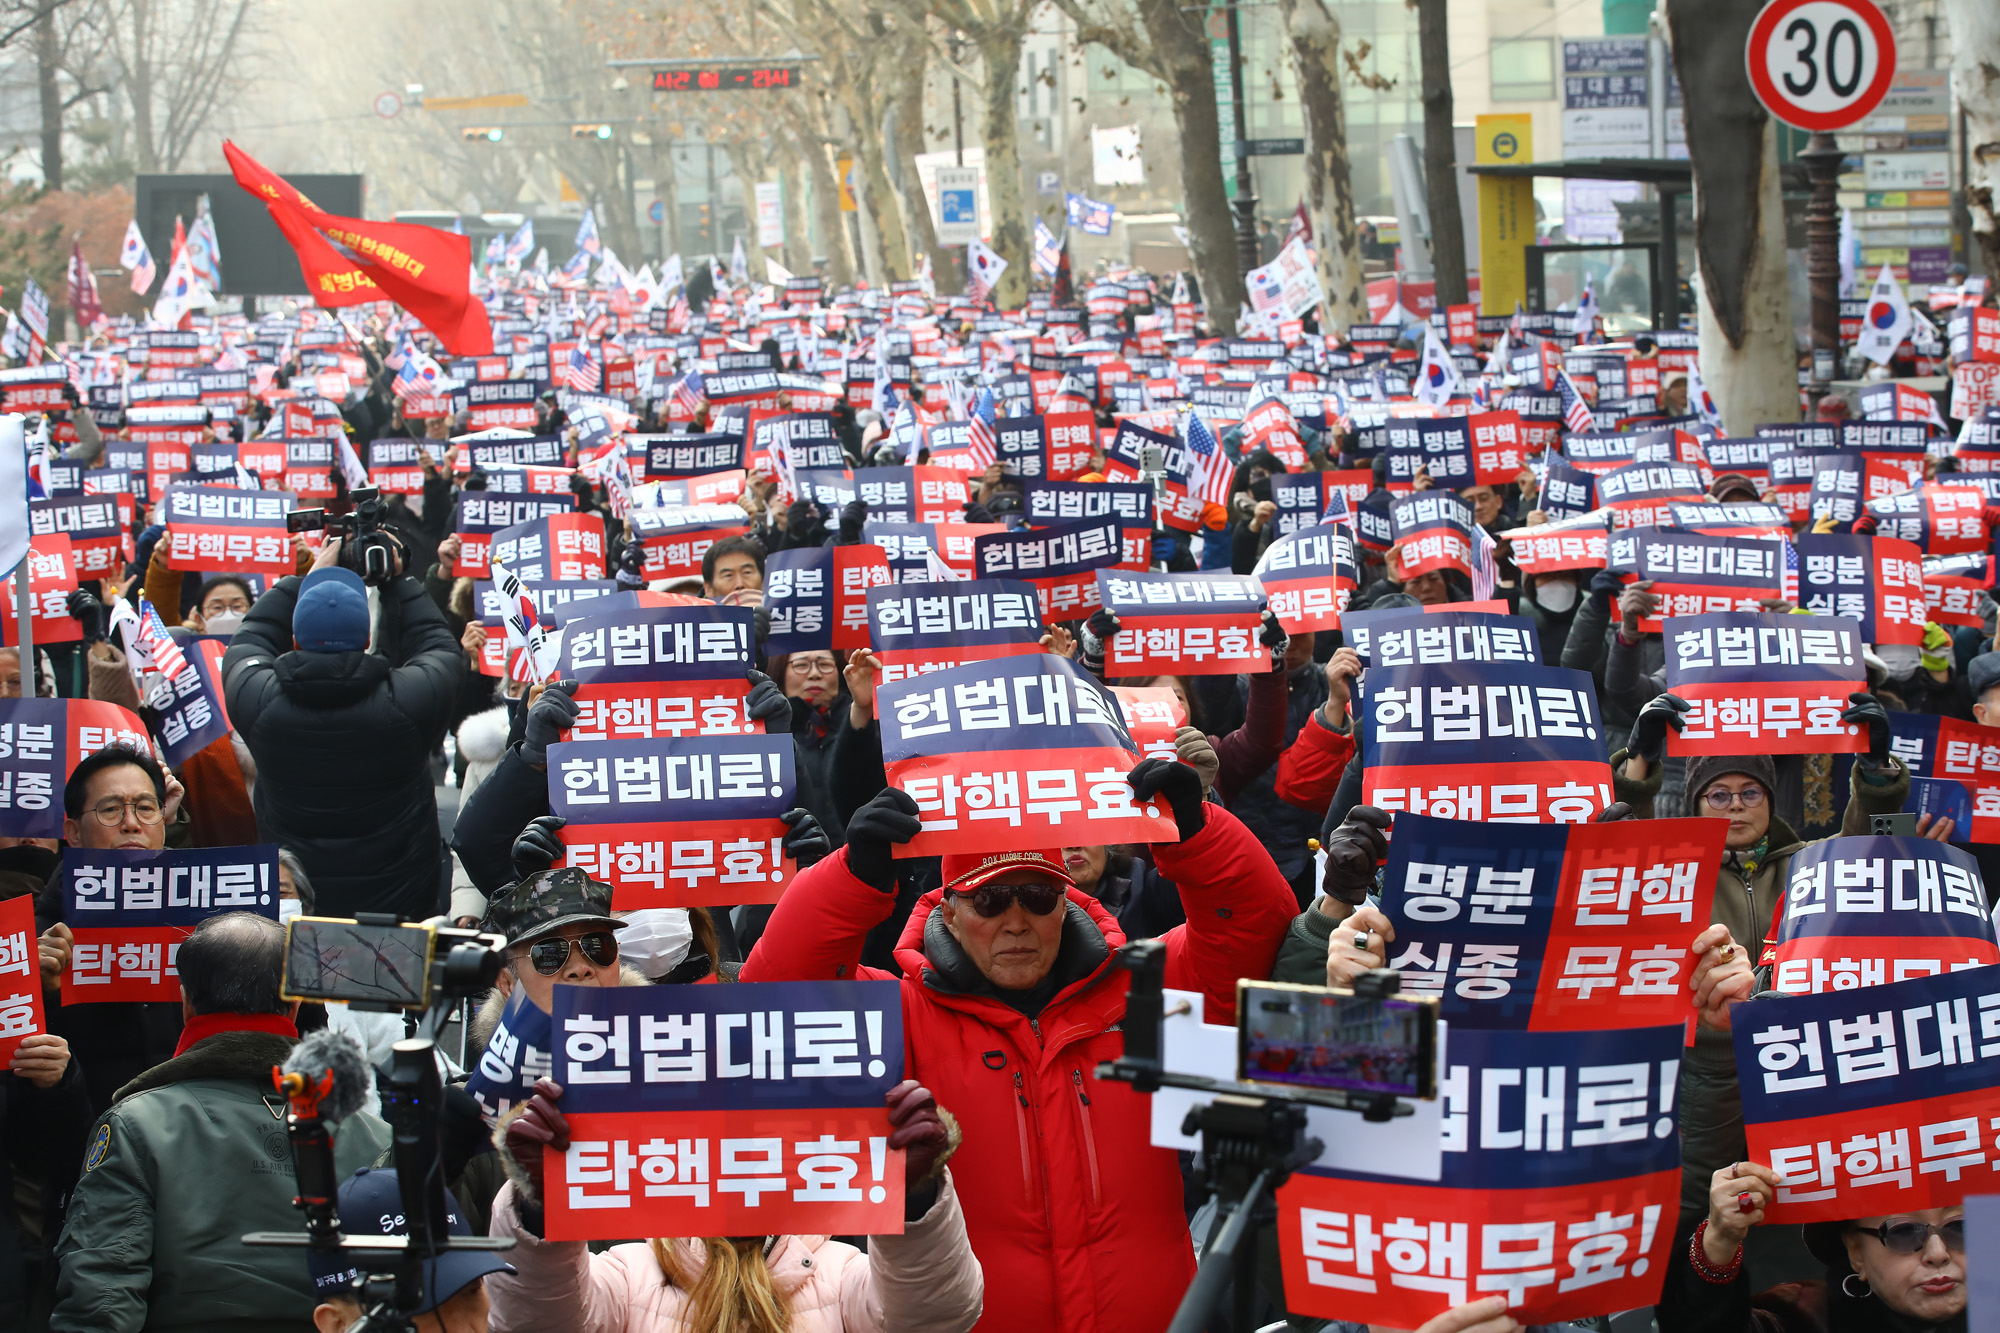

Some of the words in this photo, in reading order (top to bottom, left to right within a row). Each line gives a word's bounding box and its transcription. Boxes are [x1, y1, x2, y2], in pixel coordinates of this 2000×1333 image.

[1783, 19, 1862, 97] 30
[469, 383, 535, 401] 헌법대로!
[705, 372, 777, 394] 헌법대로!
[471, 410, 537, 428] 탄핵무효!
[1001, 429, 1040, 452] 명분
[1051, 425, 1091, 447] 탄핵
[1424, 430, 1464, 452] 명분
[1475, 424, 1517, 447] 탄핵
[1844, 425, 1925, 447] 헌법대로!
[110, 452, 144, 470] 명분
[153, 452, 188, 470] 탄핵
[244, 454, 282, 473] 탄핵
[473, 441, 561, 464] 헌법대로!
[652, 444, 738, 469] 헌법대로!
[791, 446, 843, 467] 법대로!
[1052, 451, 1092, 474] 무효
[1427, 455, 1468, 477] 실종
[1479, 451, 1519, 472] 무효
[696, 478, 739, 499] 탄핵
[860, 482, 907, 506] 명분
[922, 481, 967, 504] 탄핵
[1276, 485, 1317, 508] 명분
[1548, 480, 1586, 506] 명분
[1601, 467, 1702, 498] 헌법대로!
[1817, 470, 1860, 494] 명분
[171, 491, 291, 521] 헌법대로!
[1031, 489, 1147, 519] 헌법대로!
[1153, 489, 1201, 523] 무효!
[1395, 497, 1473, 532] 헌법대로!
[1675, 503, 1784, 525] 헌법대로!
[1813, 498, 1856, 522] 실종
[1932, 493, 1981, 512] 탄핵
[30, 503, 115, 536] 법대로!
[1936, 517, 1981, 540] 무효
[171, 532, 290, 565] 탄핵무효!
[496, 533, 542, 563] 명분
[557, 530, 601, 557] 탄핵
[983, 524, 1118, 573] 헌법대로!
[1270, 534, 1355, 571] 법대로!
[1647, 543, 1774, 578] 헌법대로!
[1807, 556, 1866, 585] 명분
[1882, 557, 1924, 592] 탄핵
[768, 568, 824, 599] 명분
[842, 564, 893, 596] 탄핵
[1106, 577, 1259, 606] 헌법대로!
[768, 606, 823, 635] 실종
[876, 593, 1038, 637] 헌법대로!
[1807, 593, 1866, 622] 실종
[1884, 595, 1927, 626] 무효
[571, 622, 749, 670] 헌법대로!
[1112, 626, 1262, 663] 탄핵무효!
[1378, 625, 1536, 667] 헌법대로!
[1675, 627, 1855, 671] 헌법대로!
[149, 663, 203, 712] 명분
[162, 694, 213, 747] 실종
[571, 694, 755, 741] 탄핵무효!
[893, 673, 1137, 752] 헌법대로!
[1375, 685, 1597, 744] 헌법대로!
[1893, 735, 1924, 771] 분
[561, 753, 784, 805] 헌법대로!
[565, 837, 784, 889] 탄핵무효!
[73, 862, 271, 911] 헌법대로!
[1403, 860, 1535, 926] 명분
[1575, 861, 1699, 927] 탄핵
[1788, 857, 1989, 923] 헌법대로!
[0, 930, 30, 977] 핵
[1390, 940, 1520, 1000] 실종
[1557, 943, 1687, 1000] 무효
[0, 993, 38, 1039] 효
[564, 1010, 887, 1086] 헌법대로!
[565, 1134, 888, 1211] 탄핵무효!
[1769, 1116, 2000, 1205] 탄핵무
[1301, 1204, 1662, 1308] 탄핵무효!
